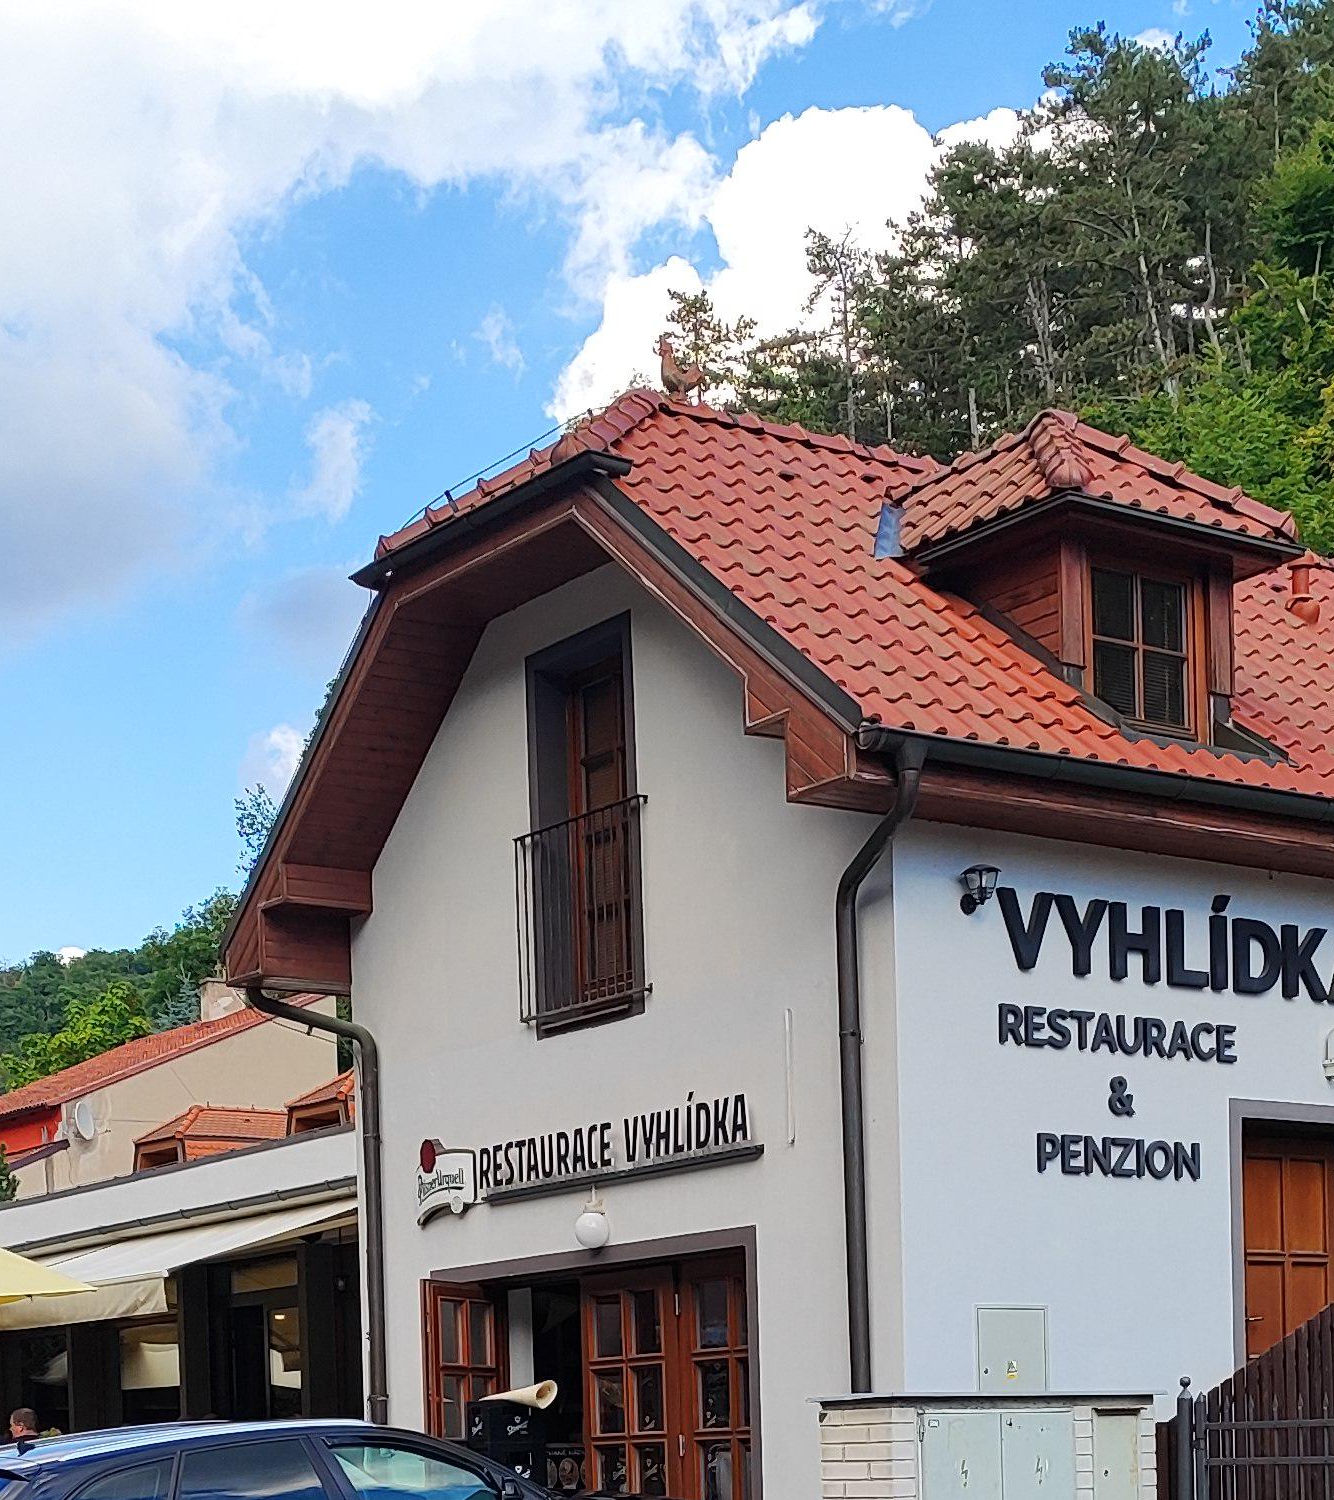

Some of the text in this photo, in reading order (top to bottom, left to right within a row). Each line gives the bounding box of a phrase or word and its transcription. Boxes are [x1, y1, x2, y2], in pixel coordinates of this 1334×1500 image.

[998, 1003, 1238, 1063] RESTAURACE
[1107, 1075, 1135, 1117] &
[479, 1091, 752, 1189] RESTAURACE VYHLÍDKA
[1036, 1132, 1201, 1181] PENZION
